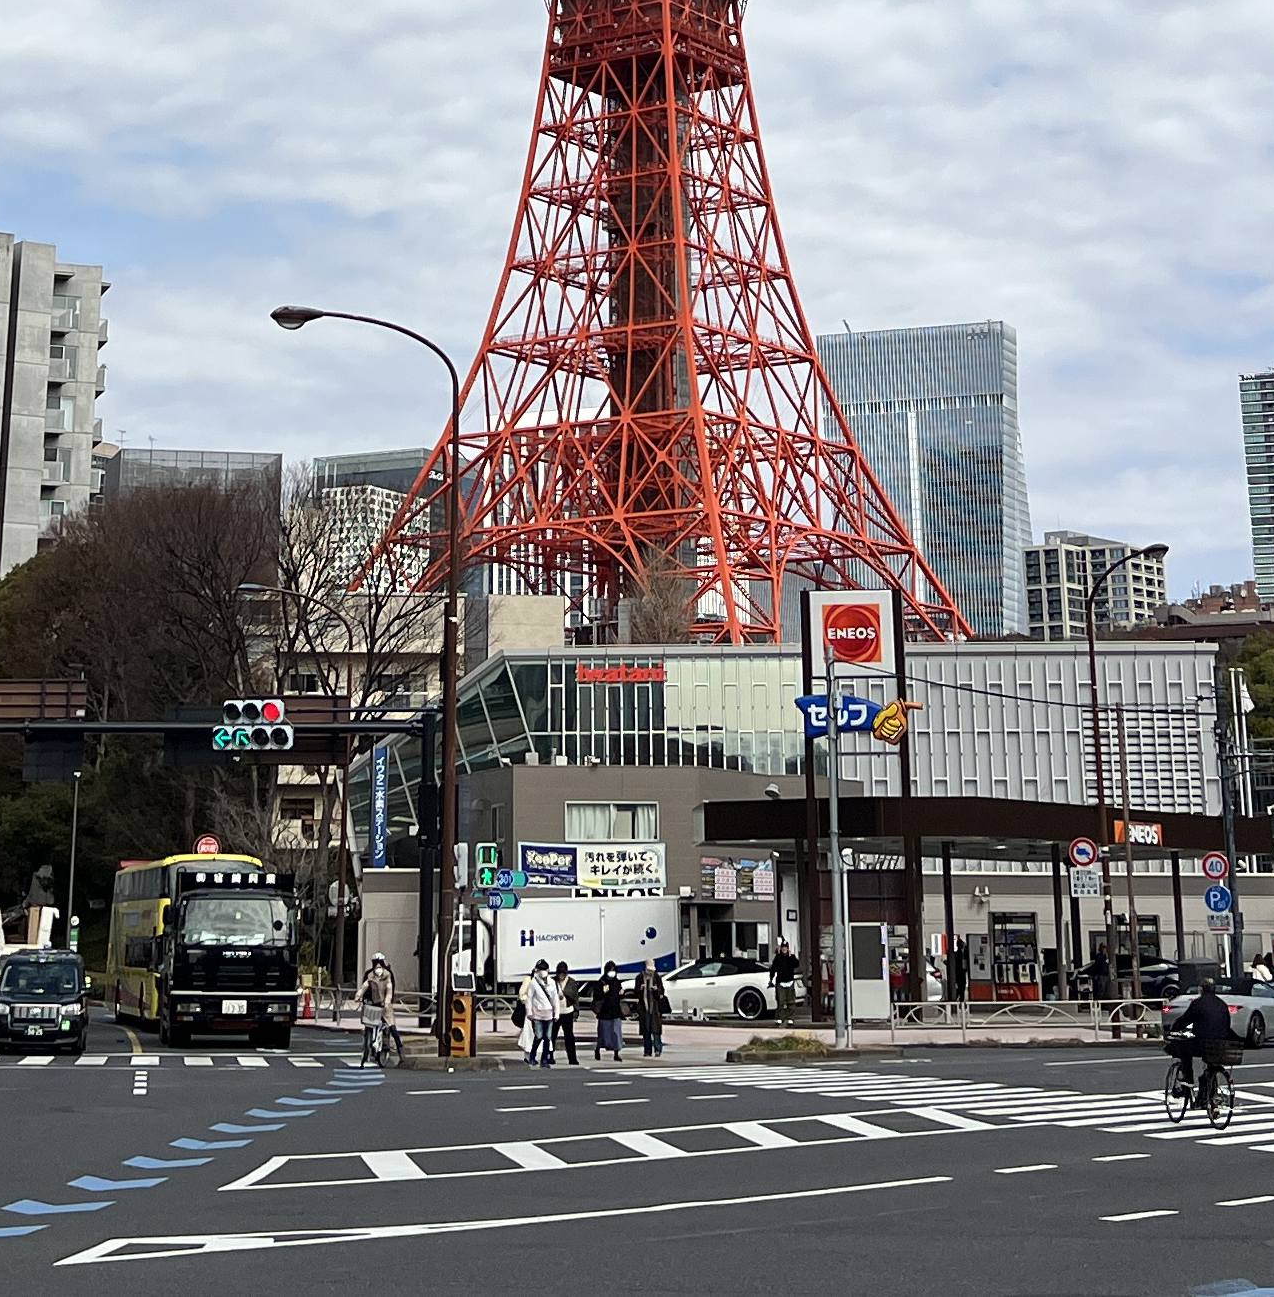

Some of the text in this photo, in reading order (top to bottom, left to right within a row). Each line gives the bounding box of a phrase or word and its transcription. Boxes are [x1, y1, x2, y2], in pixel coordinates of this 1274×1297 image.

[827, 626, 876, 641] ENEOS
[576, 663, 667, 684] iwatani
[1208, 860, 1222, 873] 40
[1209, 891, 1221, 909] P
